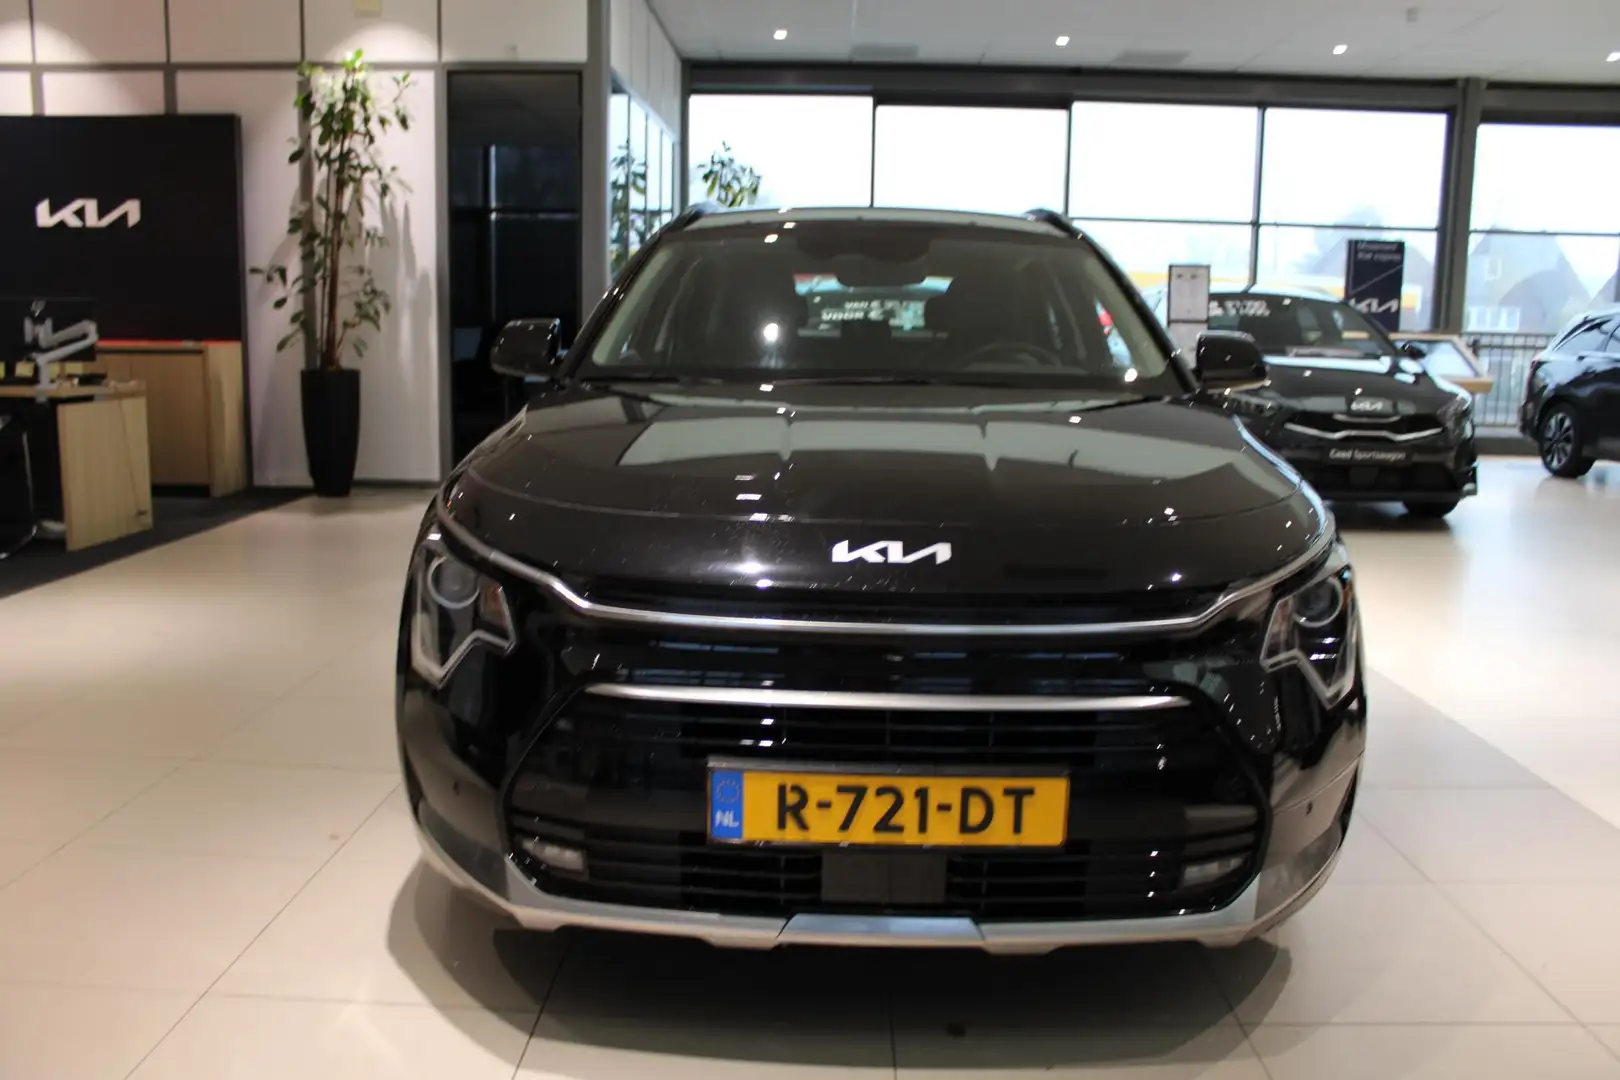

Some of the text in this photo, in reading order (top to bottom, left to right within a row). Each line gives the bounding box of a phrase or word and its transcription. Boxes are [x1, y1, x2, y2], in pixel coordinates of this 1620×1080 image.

[35, 198, 141, 228] KIA
[1351, 401, 1383, 411] KIA
[831, 539, 952, 565] KIA
[715, 810, 740, 828] NL
[776, 783, 1035, 835] R-721-DT
